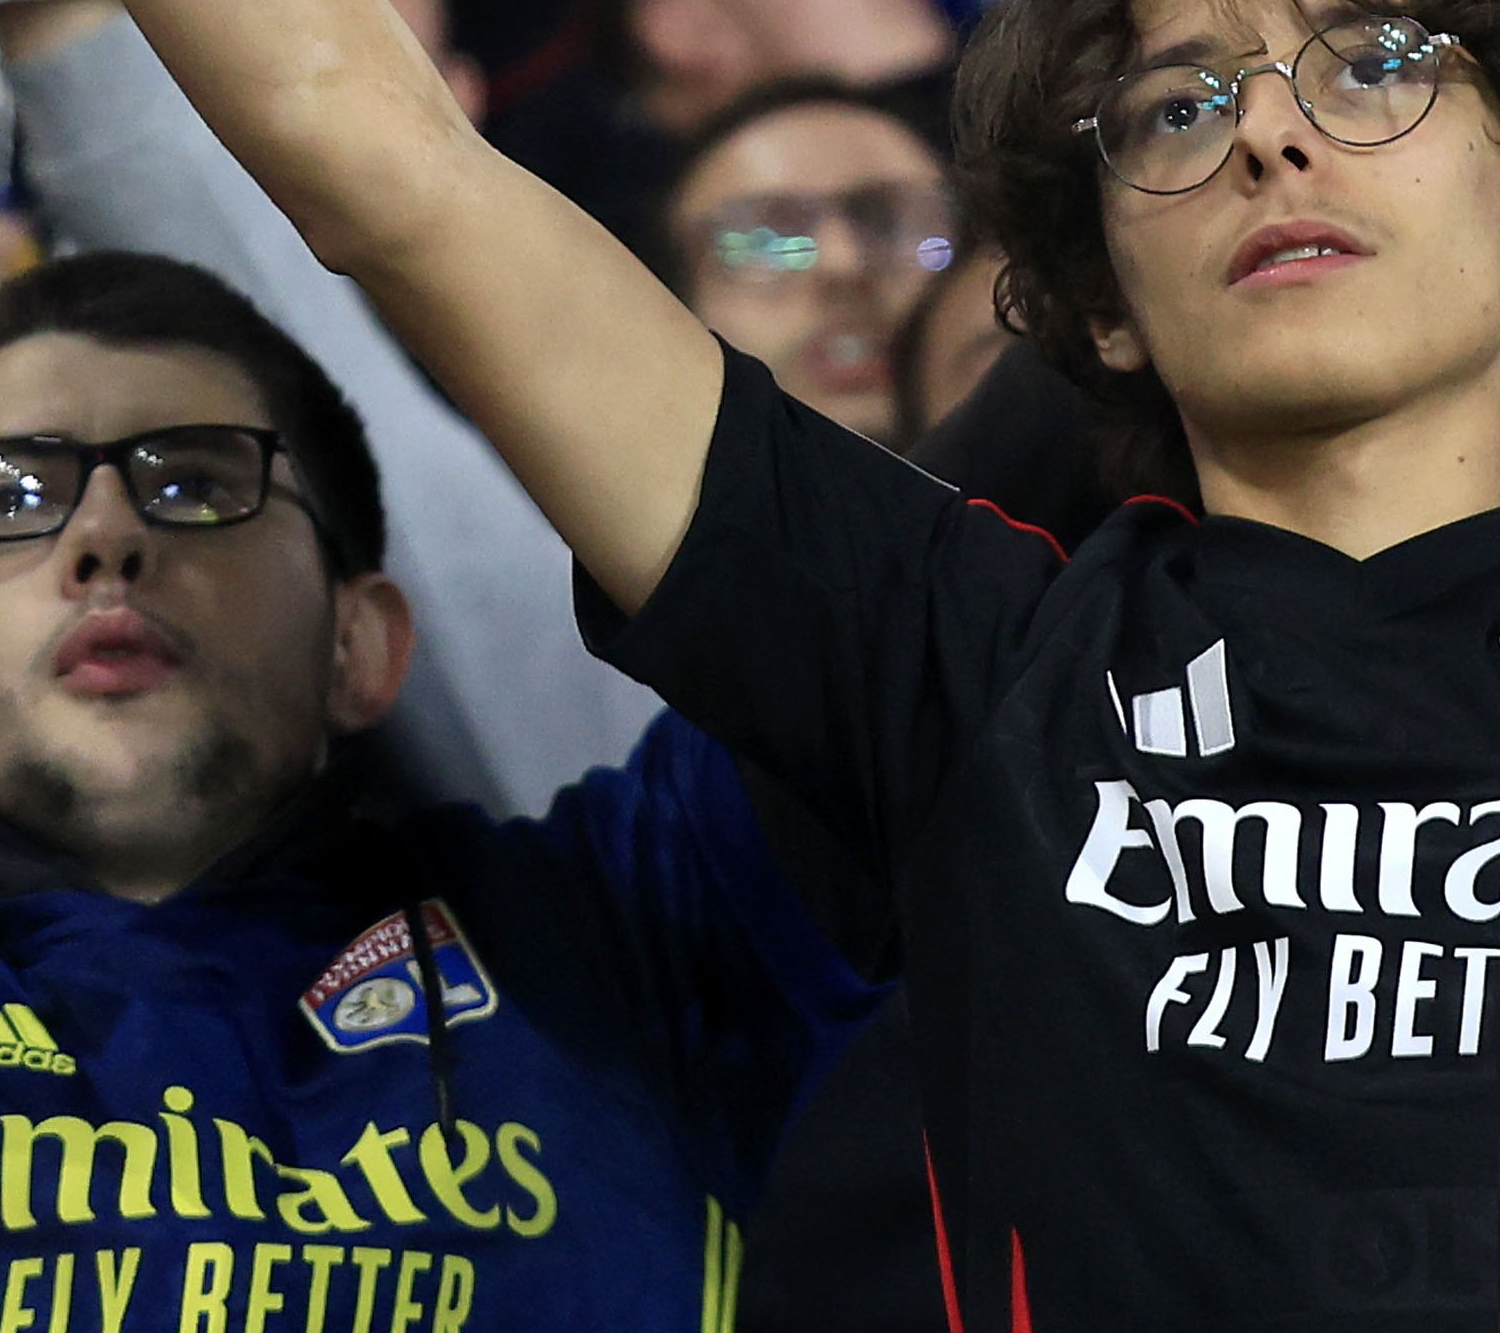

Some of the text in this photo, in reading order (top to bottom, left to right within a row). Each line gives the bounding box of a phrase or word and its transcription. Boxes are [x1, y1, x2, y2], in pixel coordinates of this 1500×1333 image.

[1145, 937, 1289, 1062] FLY
[0, 1241, 475, 1333] FLY BETTER
